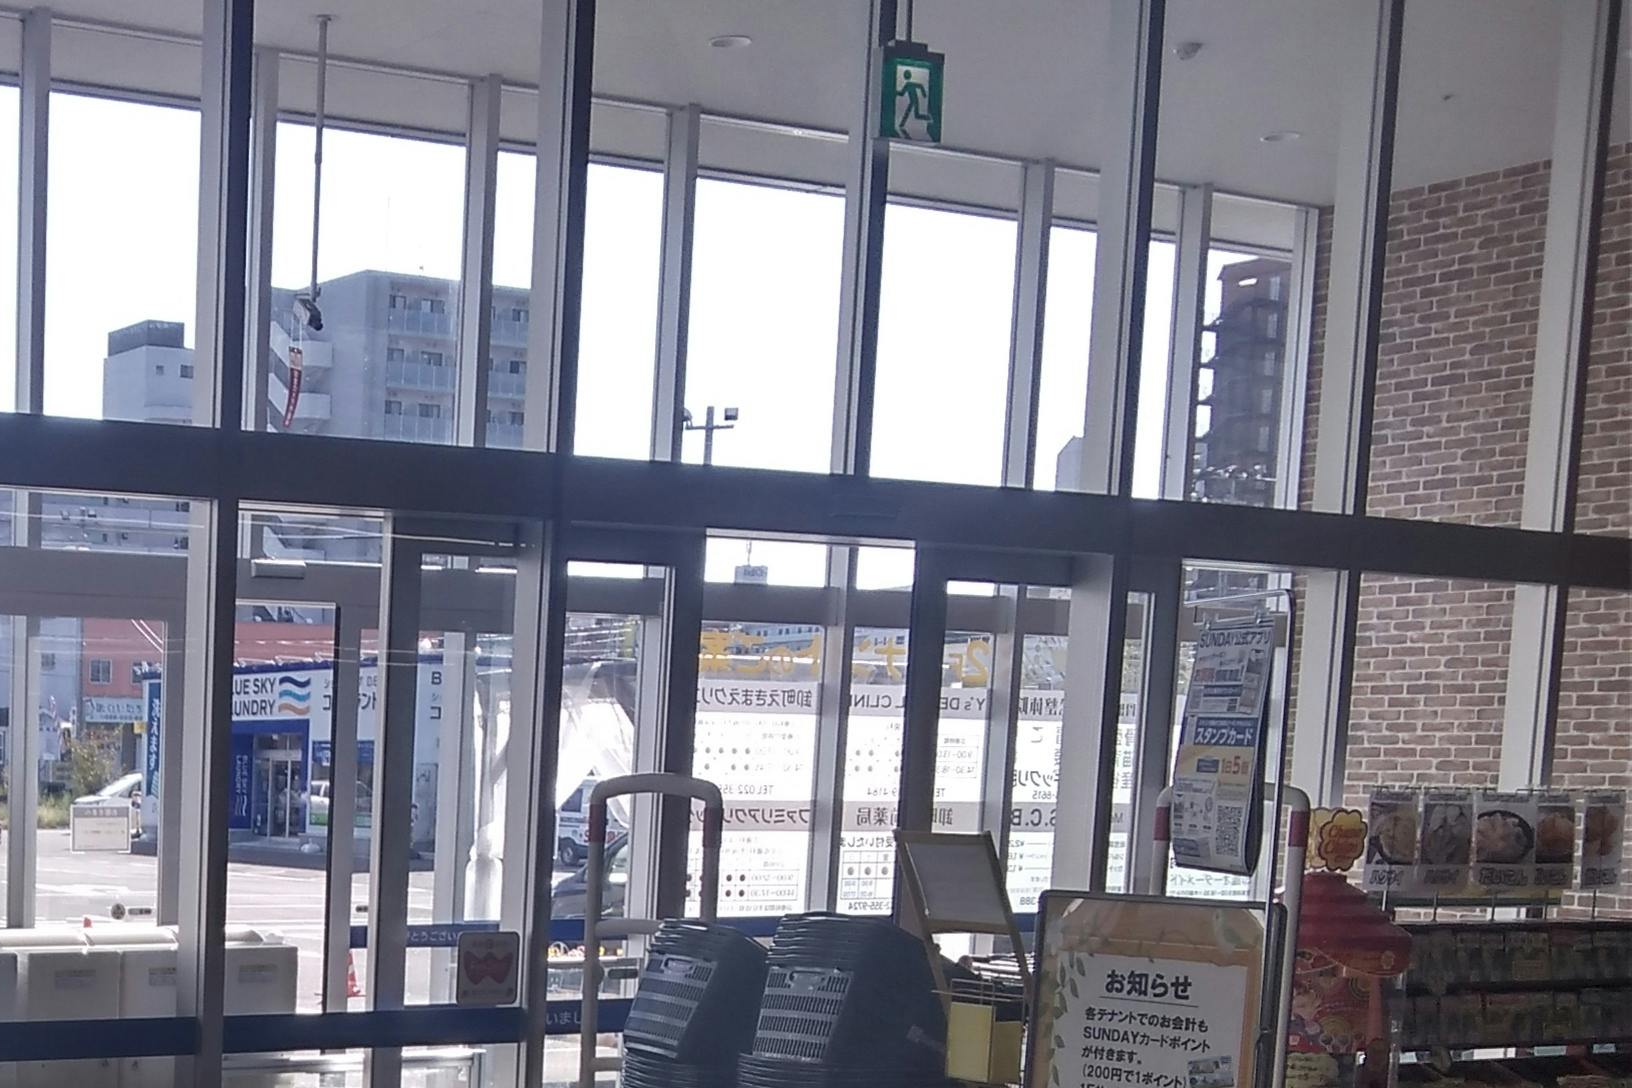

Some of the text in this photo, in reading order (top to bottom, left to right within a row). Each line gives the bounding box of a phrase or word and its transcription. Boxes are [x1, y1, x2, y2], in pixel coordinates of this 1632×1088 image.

[253, 677, 276, 695] SKY
[1194, 727, 1254, 745] スタンプカード
[1105, 969, 1193, 1000] お知らせ
[546, 1010, 582, 1025] いまし
[1084, 1006, 1209, 1033] 各テナントでのお会計も
[1083, 1026, 1211, 1053] SUNDAYカードポイント
[1081, 1046, 1143, 1065] が付きます。
